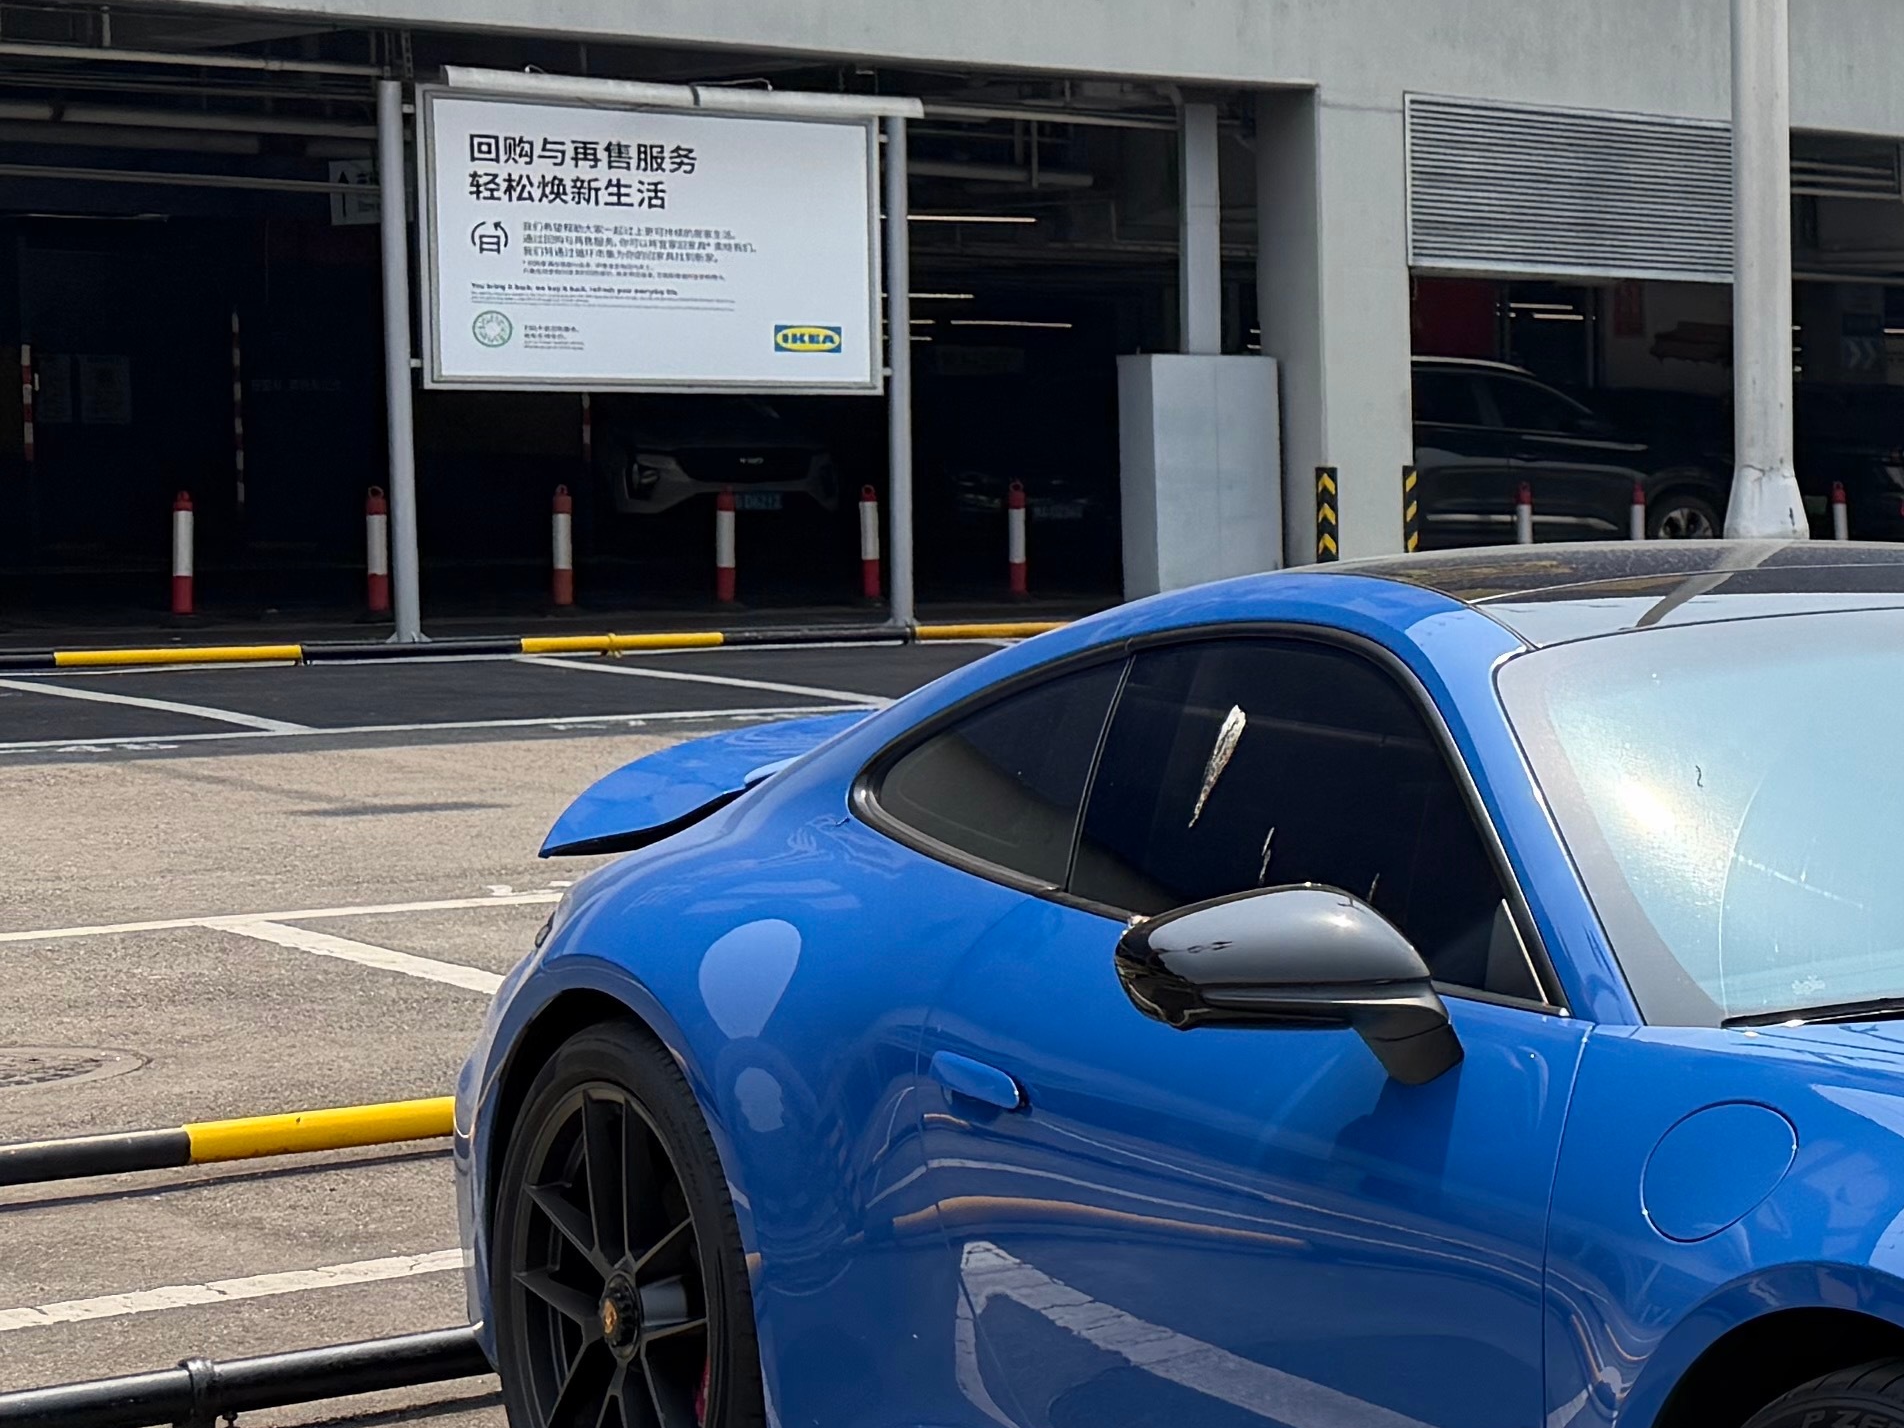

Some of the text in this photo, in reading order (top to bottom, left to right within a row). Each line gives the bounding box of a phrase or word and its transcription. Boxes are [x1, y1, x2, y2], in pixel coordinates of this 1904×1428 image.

[468, 133, 698, 175] 回购与再售服务
[468, 170, 667, 210] 轻松焕新生活
[782, 333, 837, 345] IKEA
